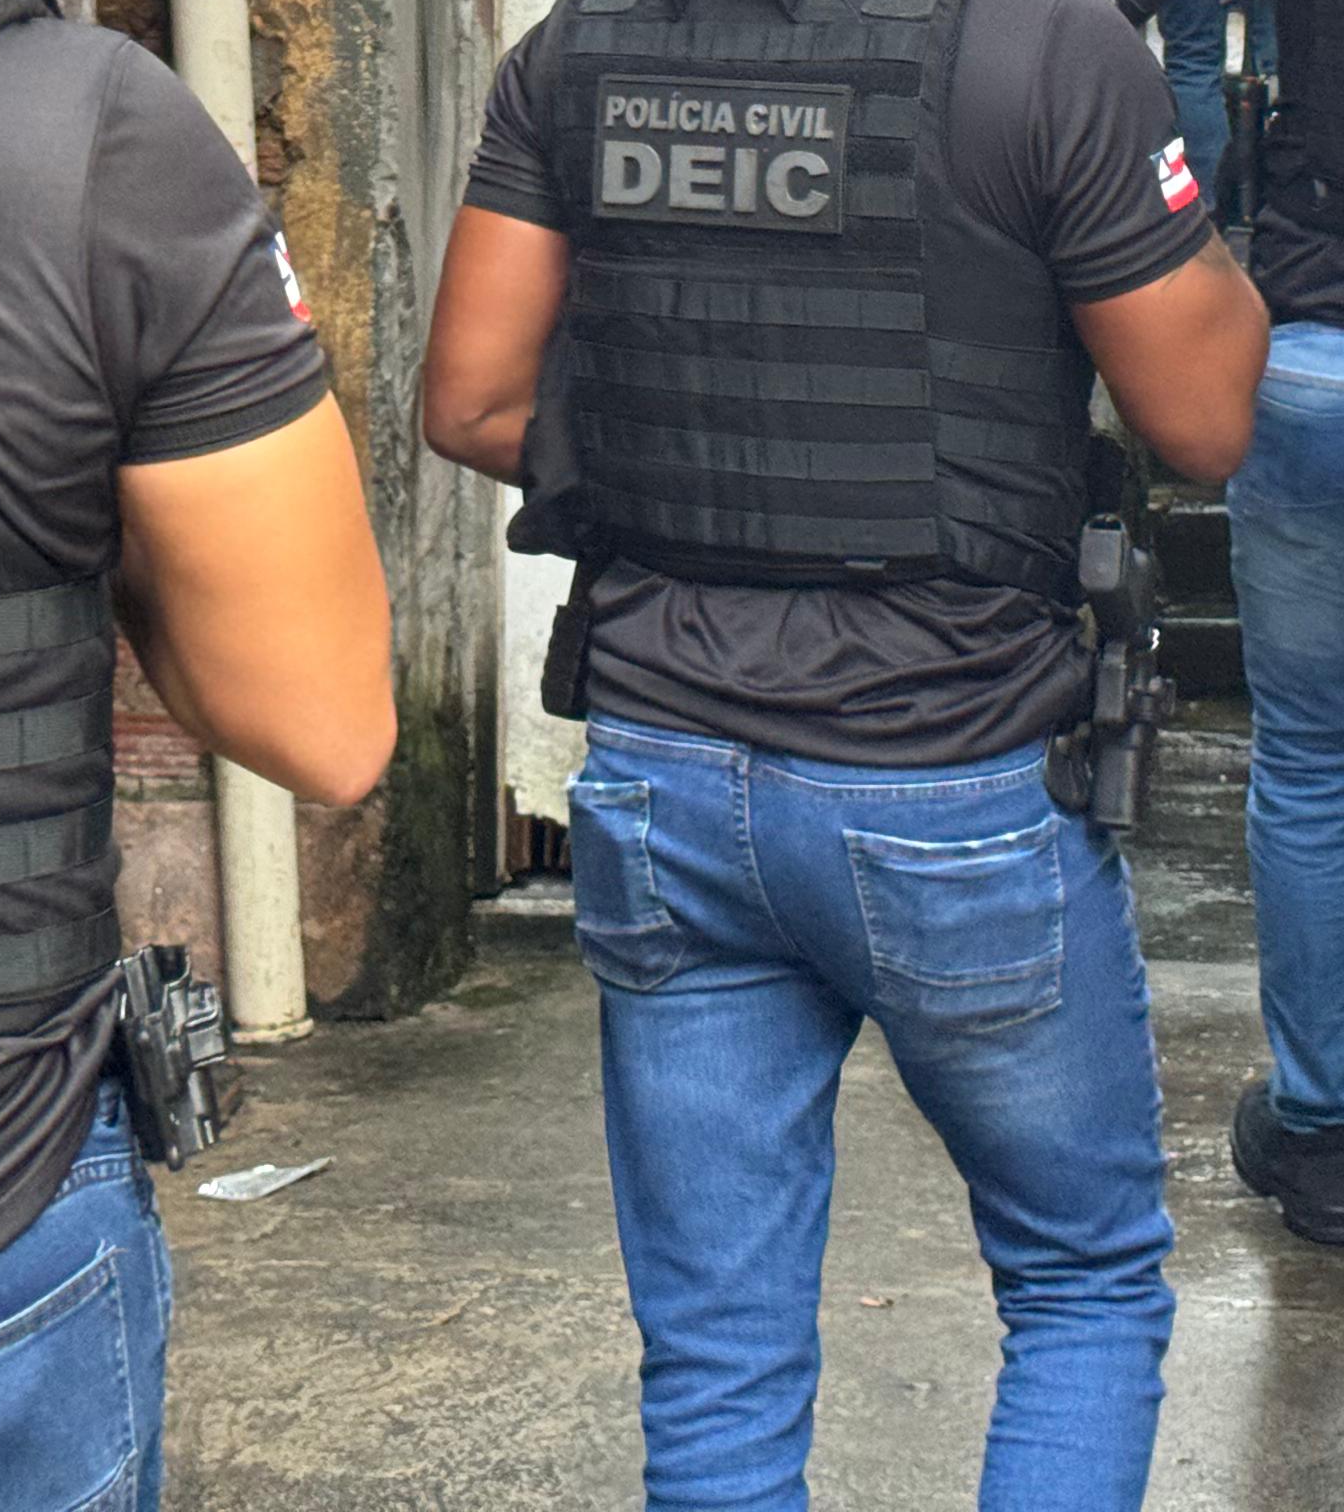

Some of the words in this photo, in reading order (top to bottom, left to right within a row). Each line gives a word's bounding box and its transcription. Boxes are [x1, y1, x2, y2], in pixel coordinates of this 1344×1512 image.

[606, 91, 736, 134] POLÍCIA
[745, 103, 835, 139] CIVIL
[602, 140, 831, 218] DEIC
